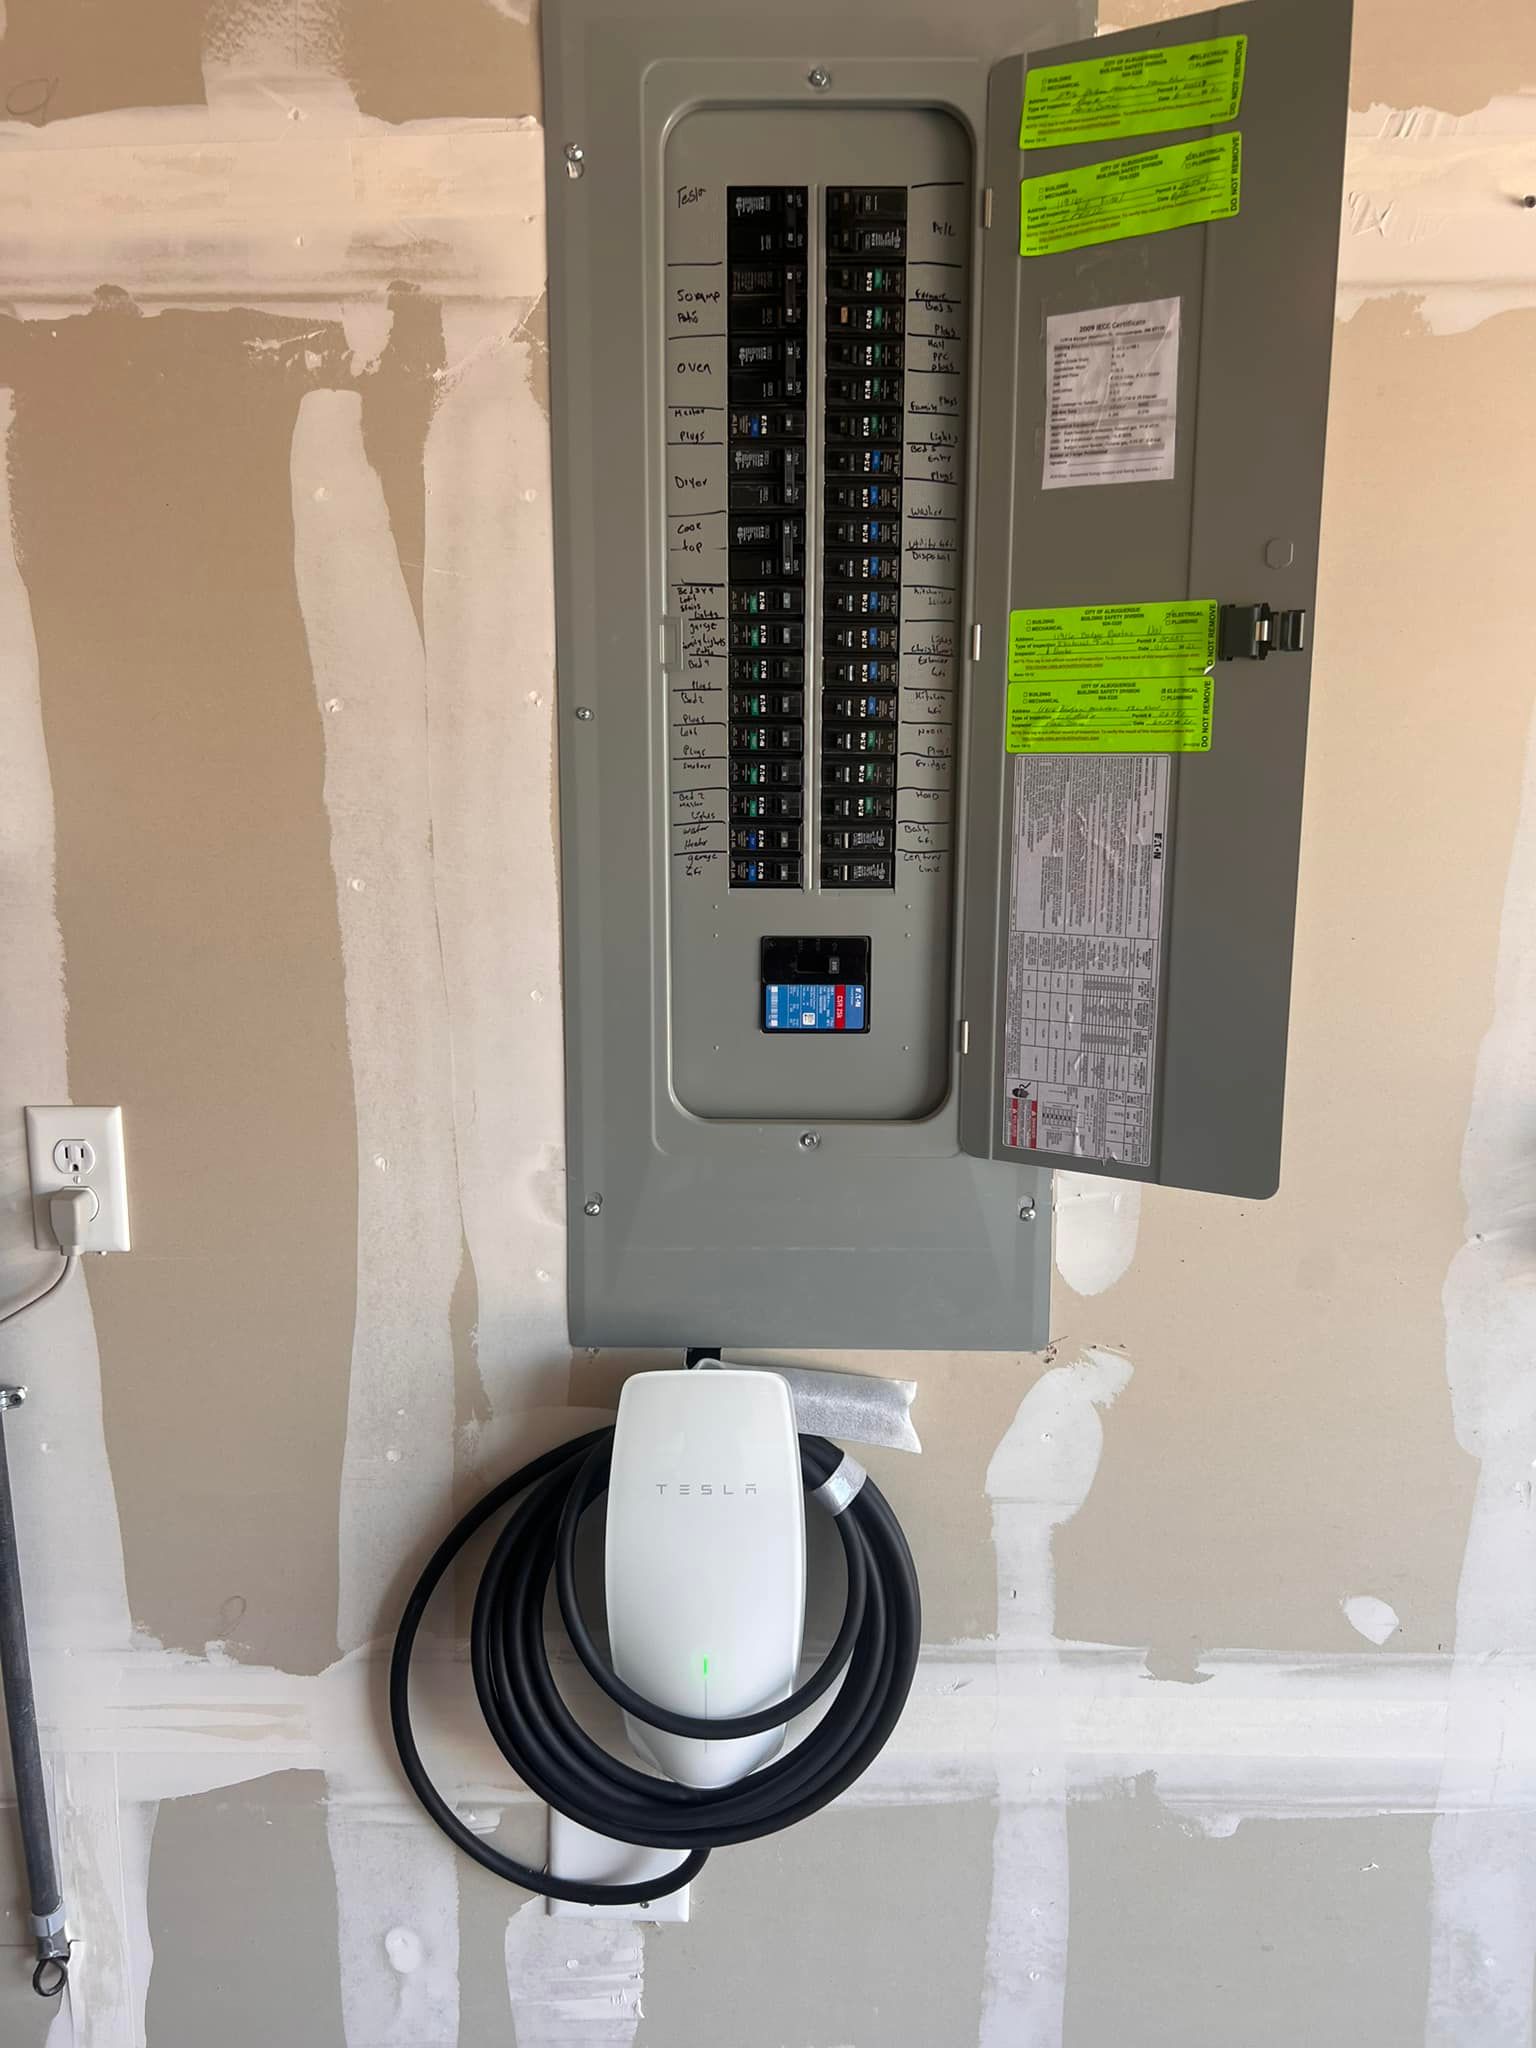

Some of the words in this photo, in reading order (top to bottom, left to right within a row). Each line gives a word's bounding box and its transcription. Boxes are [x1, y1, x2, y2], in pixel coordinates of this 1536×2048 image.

[1234, 40, 1244, 78] REMOVE
[1231, 137, 1240, 174] REMOVE
[1230, 178, 1238, 195] NOT
[1230, 200, 1238, 212] DO
[1079, 324, 1094, 333] 2009
[1112, 318, 1146, 330] Certificate
[1208, 604, 1216, 638] REMOVE
[1203, 680, 1211, 714] REMOVE
[1201, 736, 1208, 748] DO
[656, 1484, 756, 1495] TESLA
